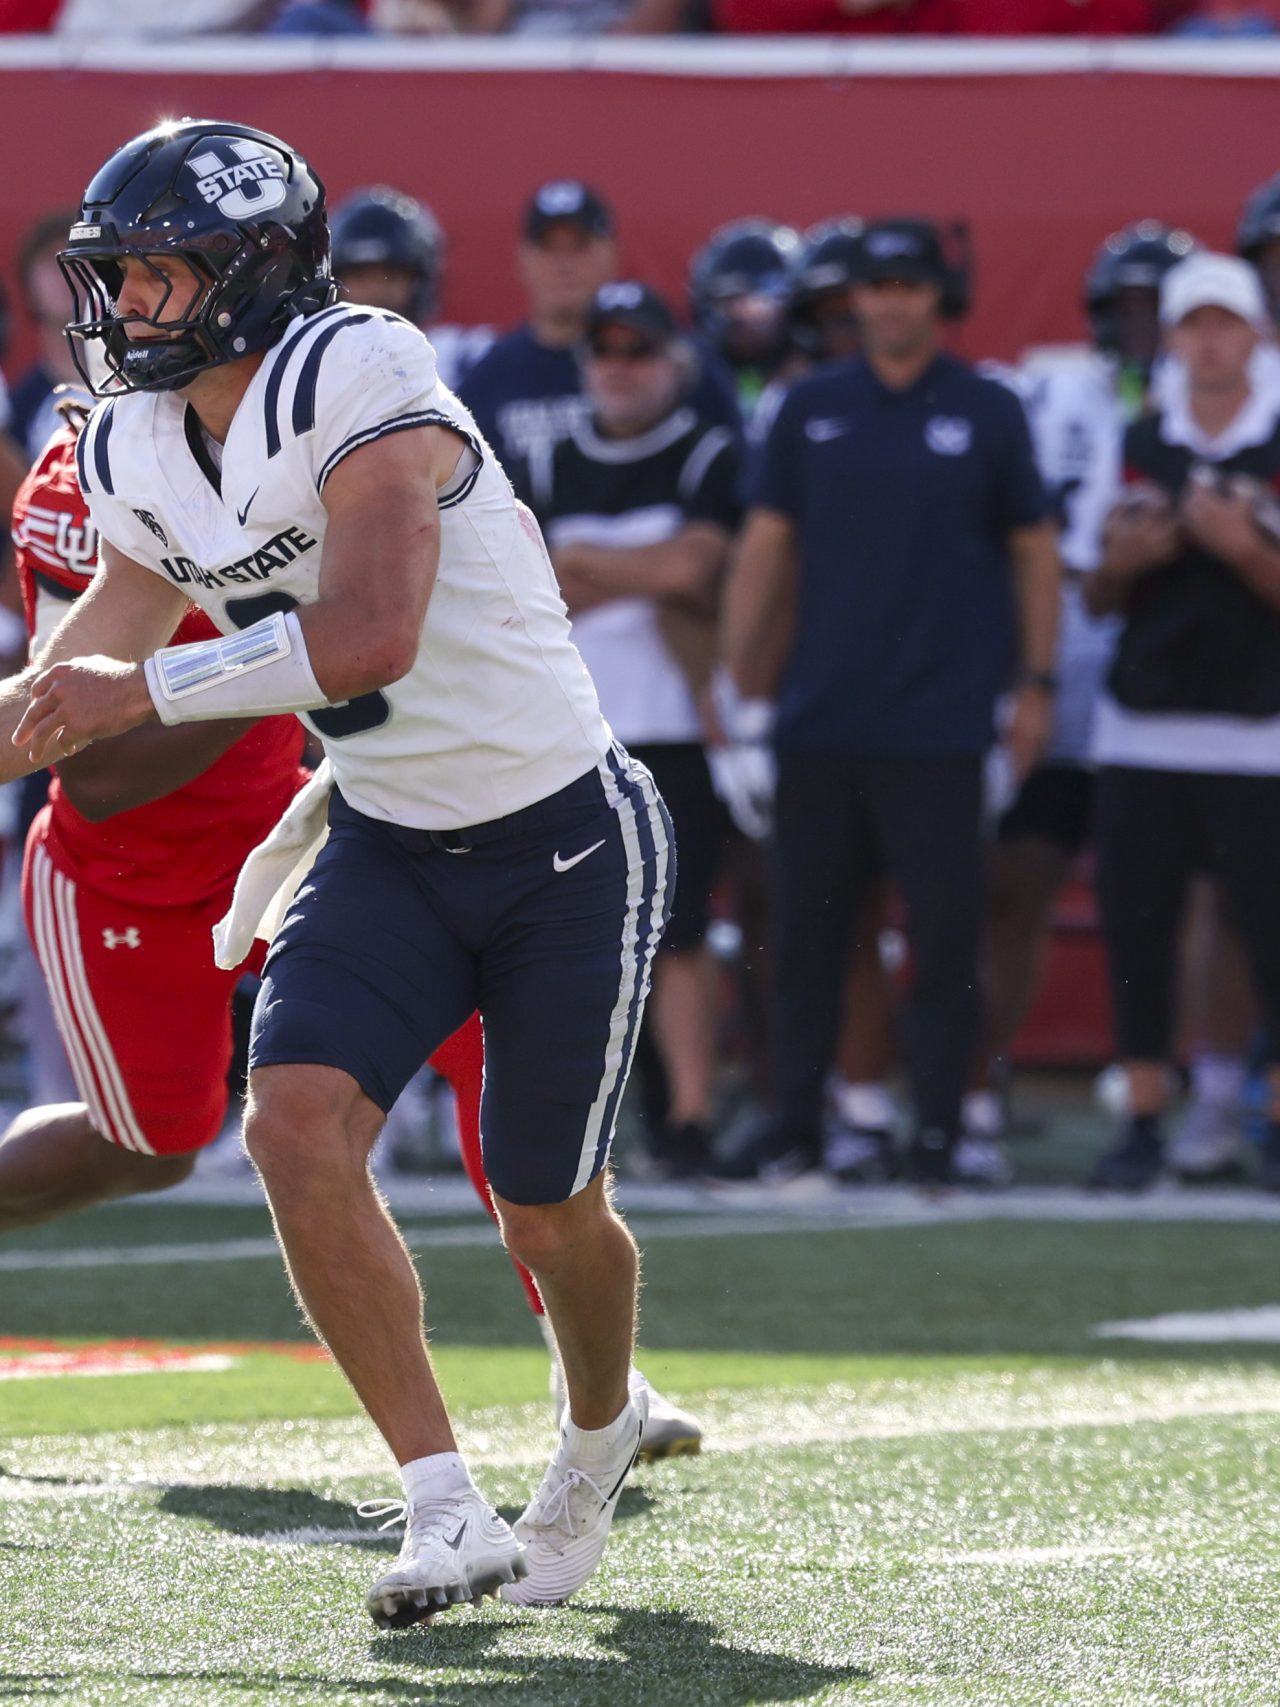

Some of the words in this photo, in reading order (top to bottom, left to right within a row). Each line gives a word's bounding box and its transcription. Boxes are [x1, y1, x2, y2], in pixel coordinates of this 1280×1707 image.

[185, 140, 286, 219] U
[196, 157, 284, 204] STATE
[218, 526, 318, 584] STATE
